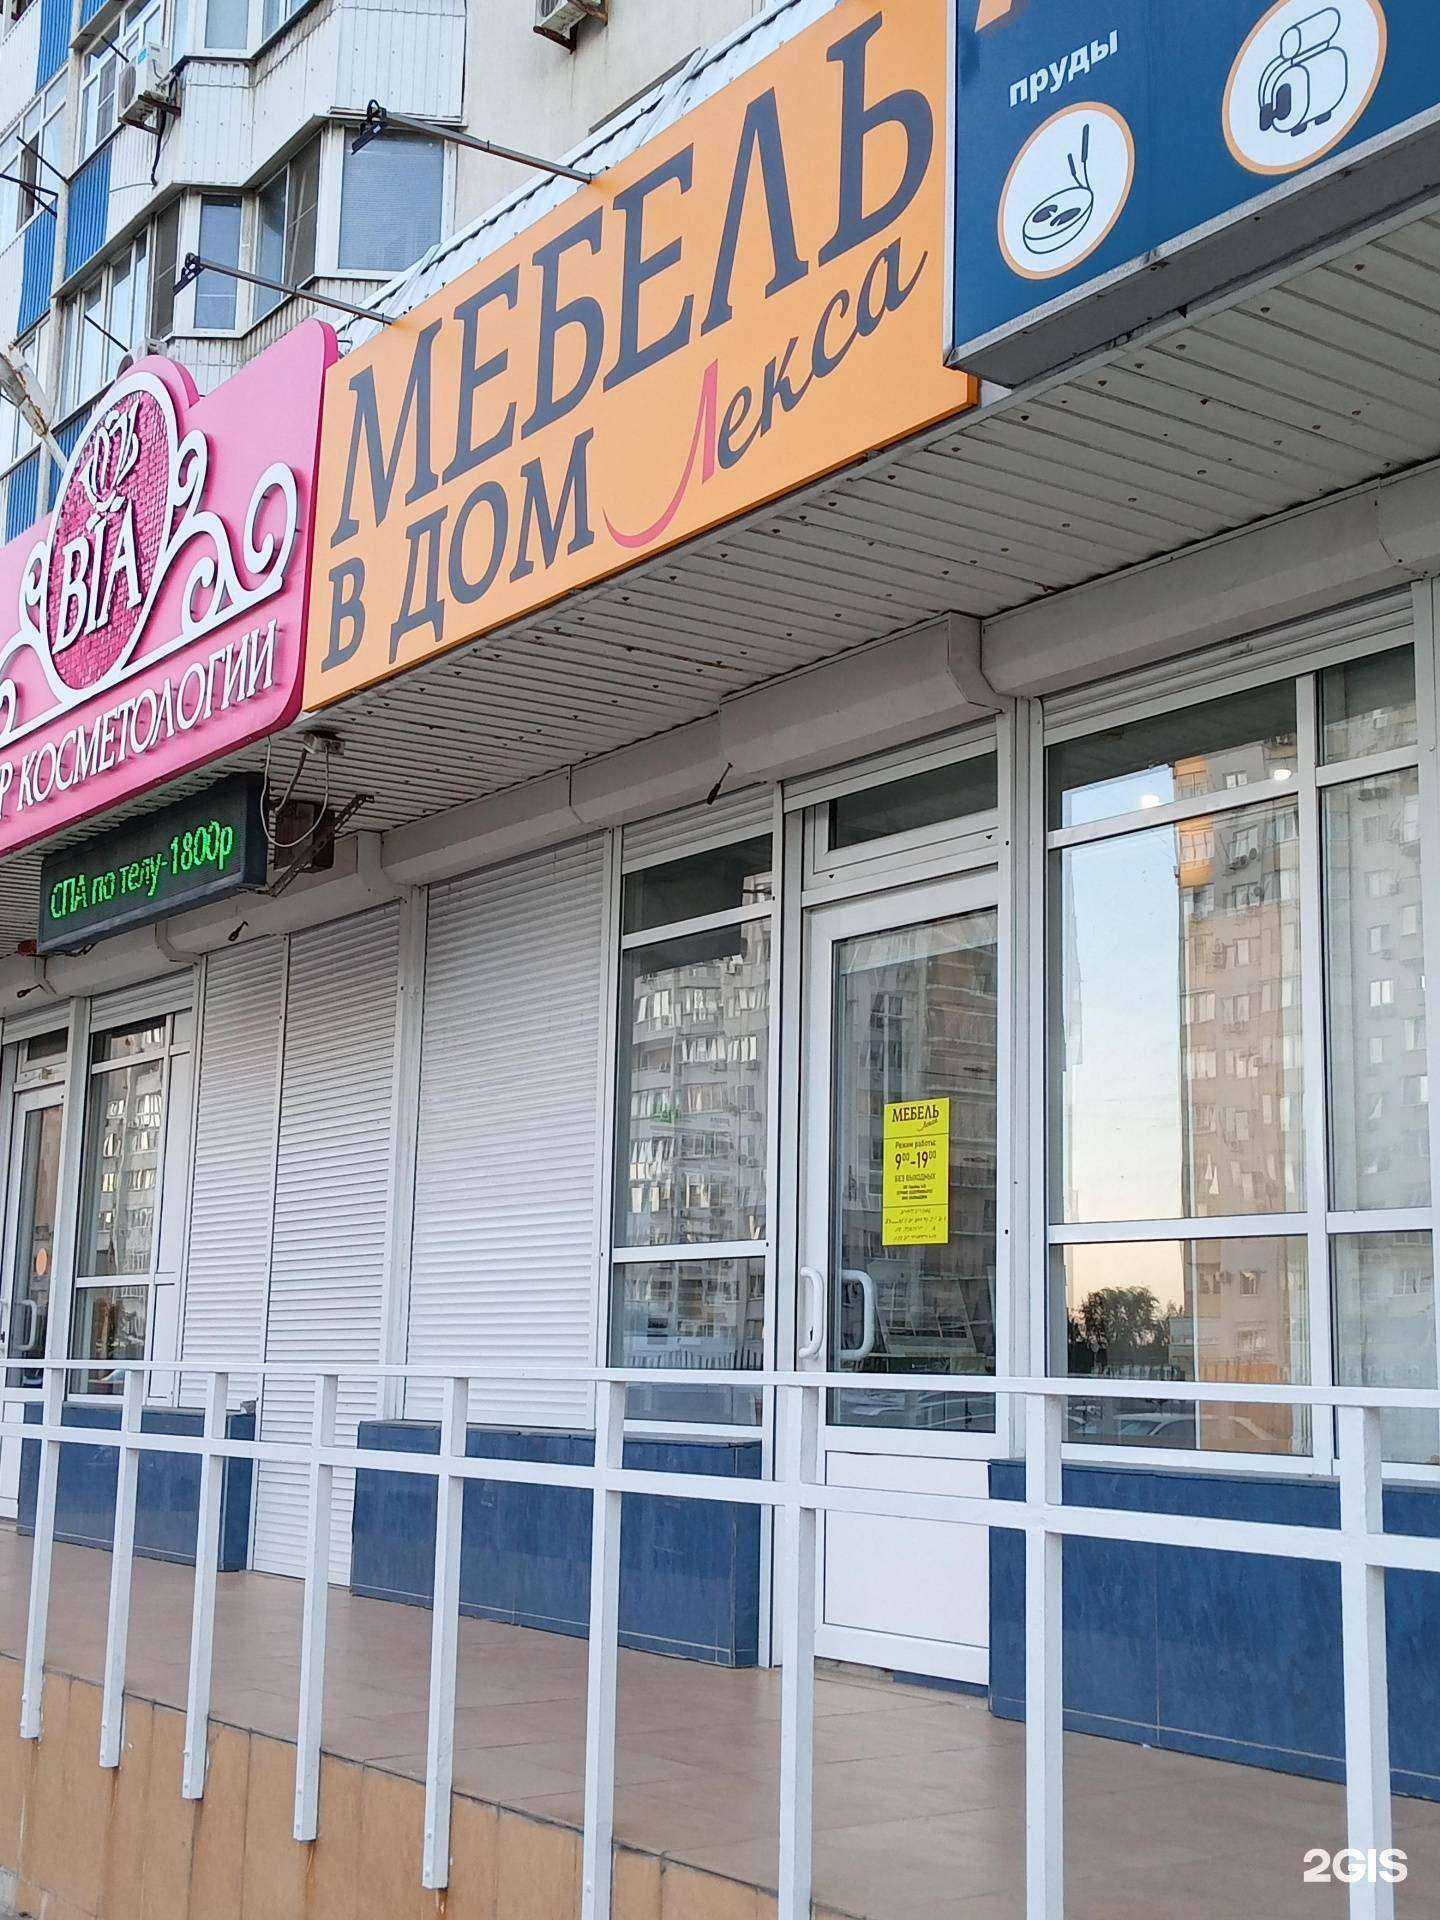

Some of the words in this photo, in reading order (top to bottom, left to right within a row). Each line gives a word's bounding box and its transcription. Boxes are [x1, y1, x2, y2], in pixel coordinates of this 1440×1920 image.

[1009, 30, 1119, 107] пруды
[330, 11, 934, 549] МЕБЕЛЬ
[602, 237, 928, 548] Лекса
[388, 427, 594, 664] ДОМ
[17, 618, 278, 812] КОСМЕТОЛОГИИ
[50, 874, 88, 919] СПА
[91, 871, 117, 905] по
[892, 1105, 939, 1122] МЕБЕЛЬ
